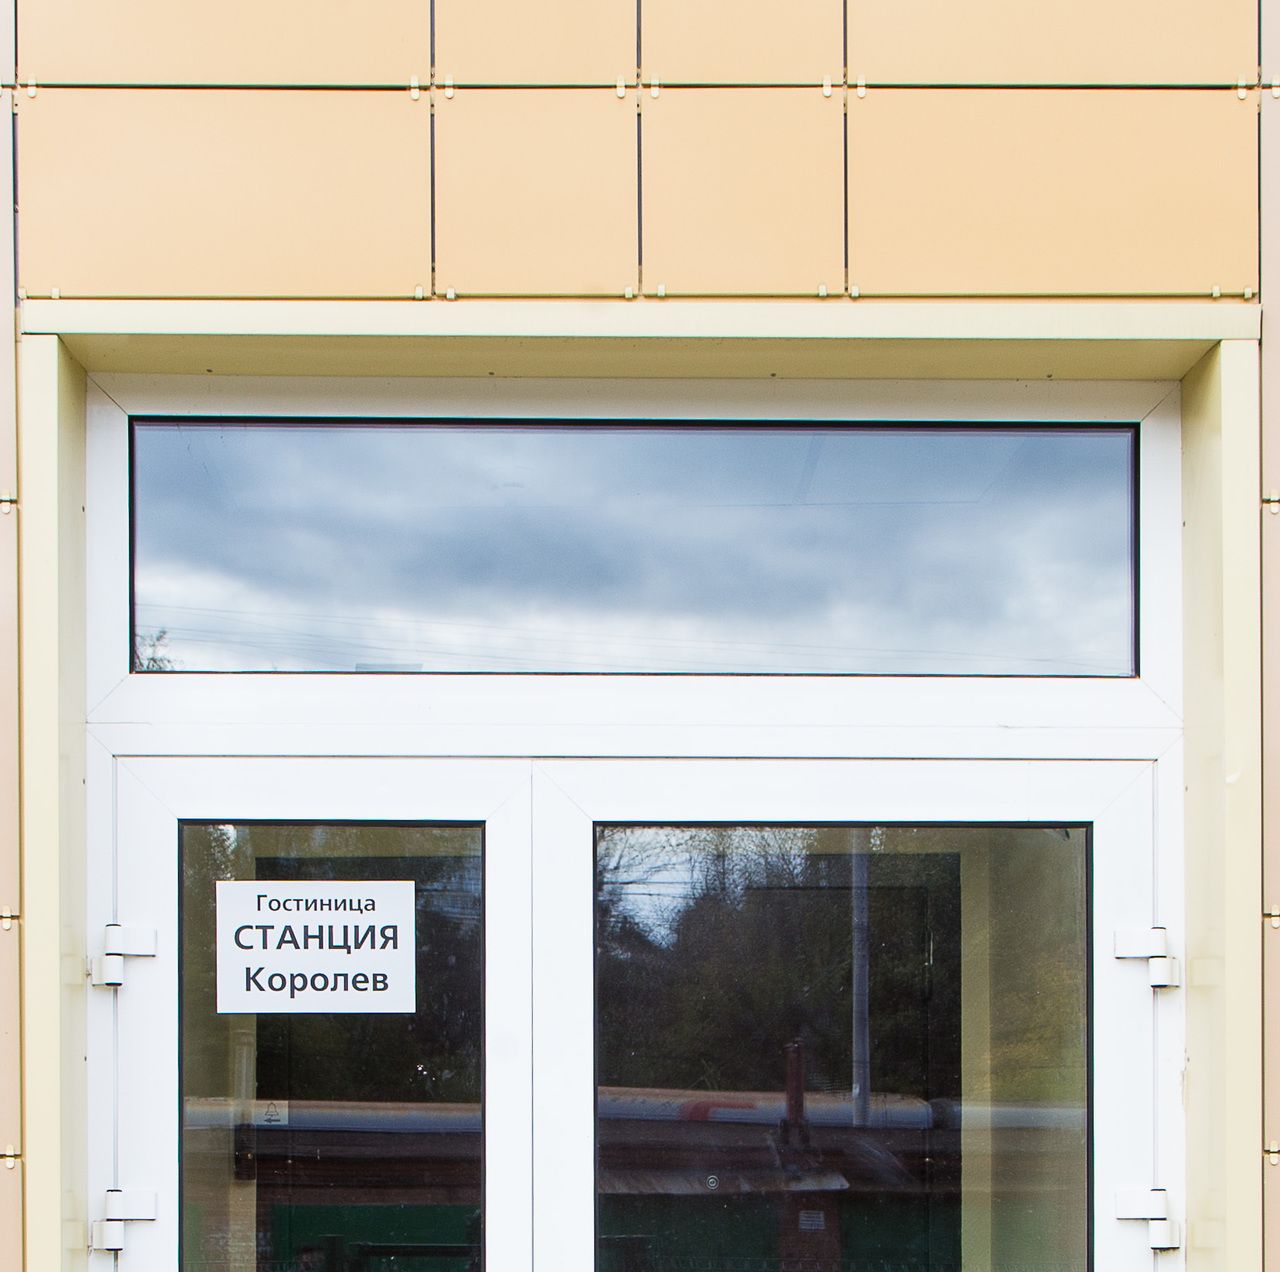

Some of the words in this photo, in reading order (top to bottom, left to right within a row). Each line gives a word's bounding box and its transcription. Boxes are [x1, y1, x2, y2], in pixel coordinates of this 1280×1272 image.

[256, 894, 376, 914] Гостиница
[233, 924, 399, 955] СТАНЦИЯ
[244, 966, 389, 999] Королев
